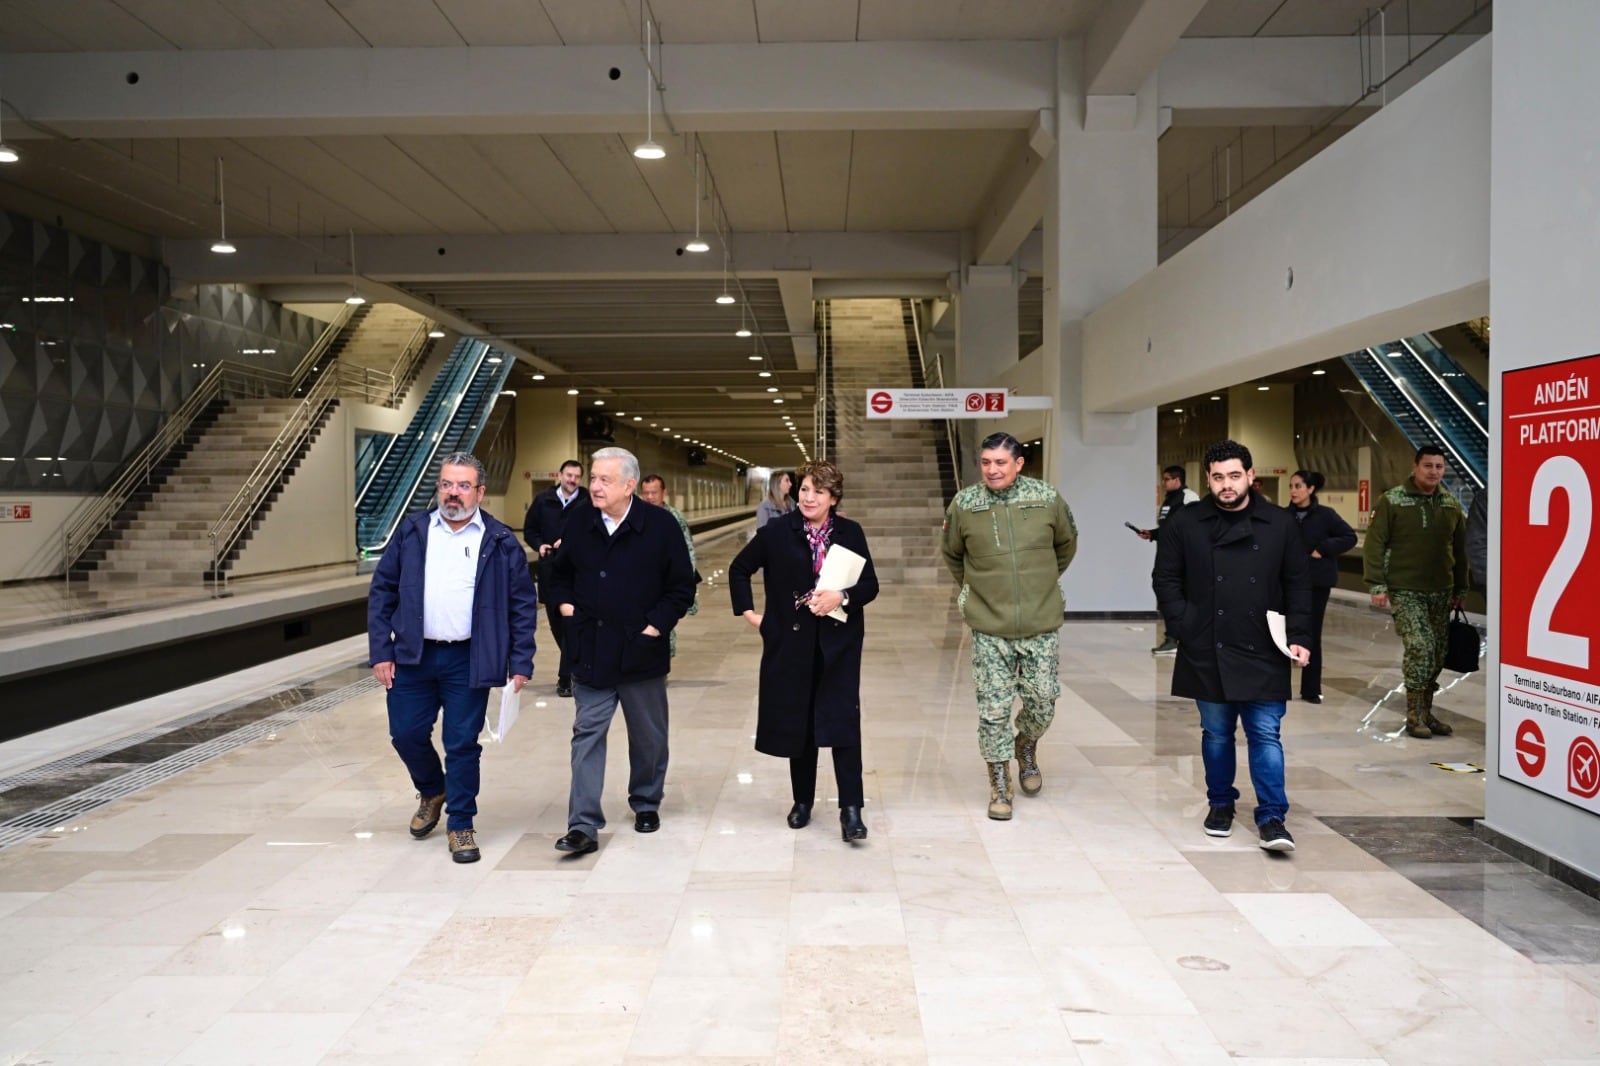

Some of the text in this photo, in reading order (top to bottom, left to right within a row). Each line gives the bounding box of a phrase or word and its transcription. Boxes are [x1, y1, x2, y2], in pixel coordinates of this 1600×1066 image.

[1534, 373, 1588, 405] ANDÉN
[991, 400, 998, 410] 2
[1520, 417, 1600, 445] PLATFORM
[1361, 489, 1366, 511] 1
[1527, 456, 1592, 669] 2
[1514, 674, 1541, 690] Terminal
[1543, 681, 1581, 701] Suburbano
[1508, 693, 1542, 712] Suburbano
[1544, 703, 1561, 718] Train
[1562, 708, 1588, 726] Station
